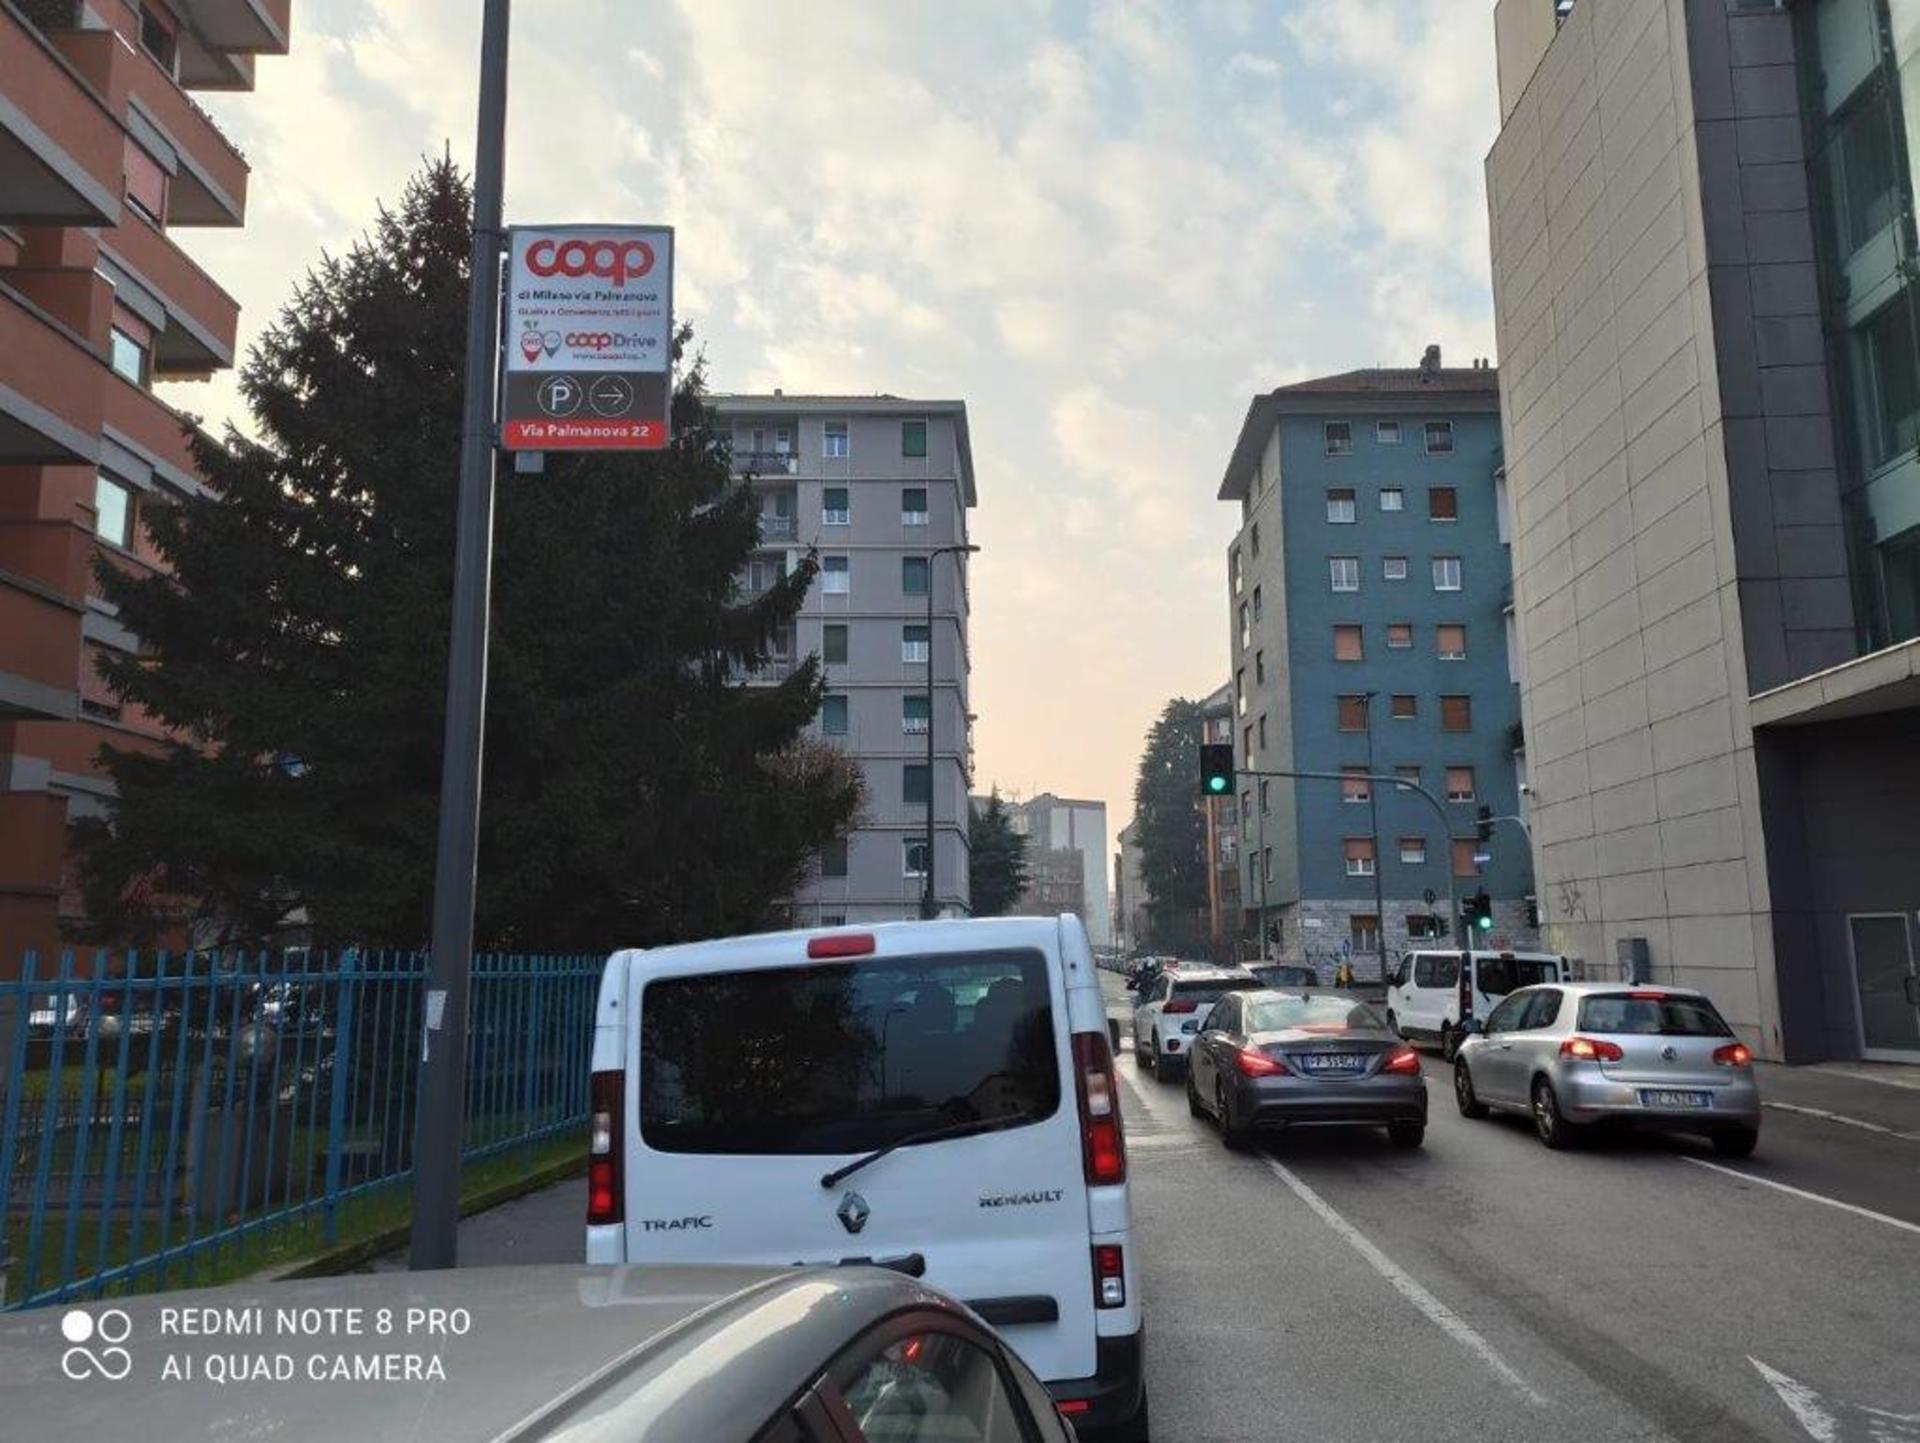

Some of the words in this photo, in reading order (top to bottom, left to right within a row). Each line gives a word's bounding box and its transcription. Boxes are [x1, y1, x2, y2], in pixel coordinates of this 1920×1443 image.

[526, 239, 655, 288] coop
[595, 290, 658, 301] Palmanova
[551, 386, 570, 410] P
[520, 424, 544, 437] Via
[548, 424, 629, 437] Palmanova
[631, 425, 649, 437] 22
[979, 1189, 1064, 1207] RENAULT
[641, 1215, 713, 1232] TRAFIC
